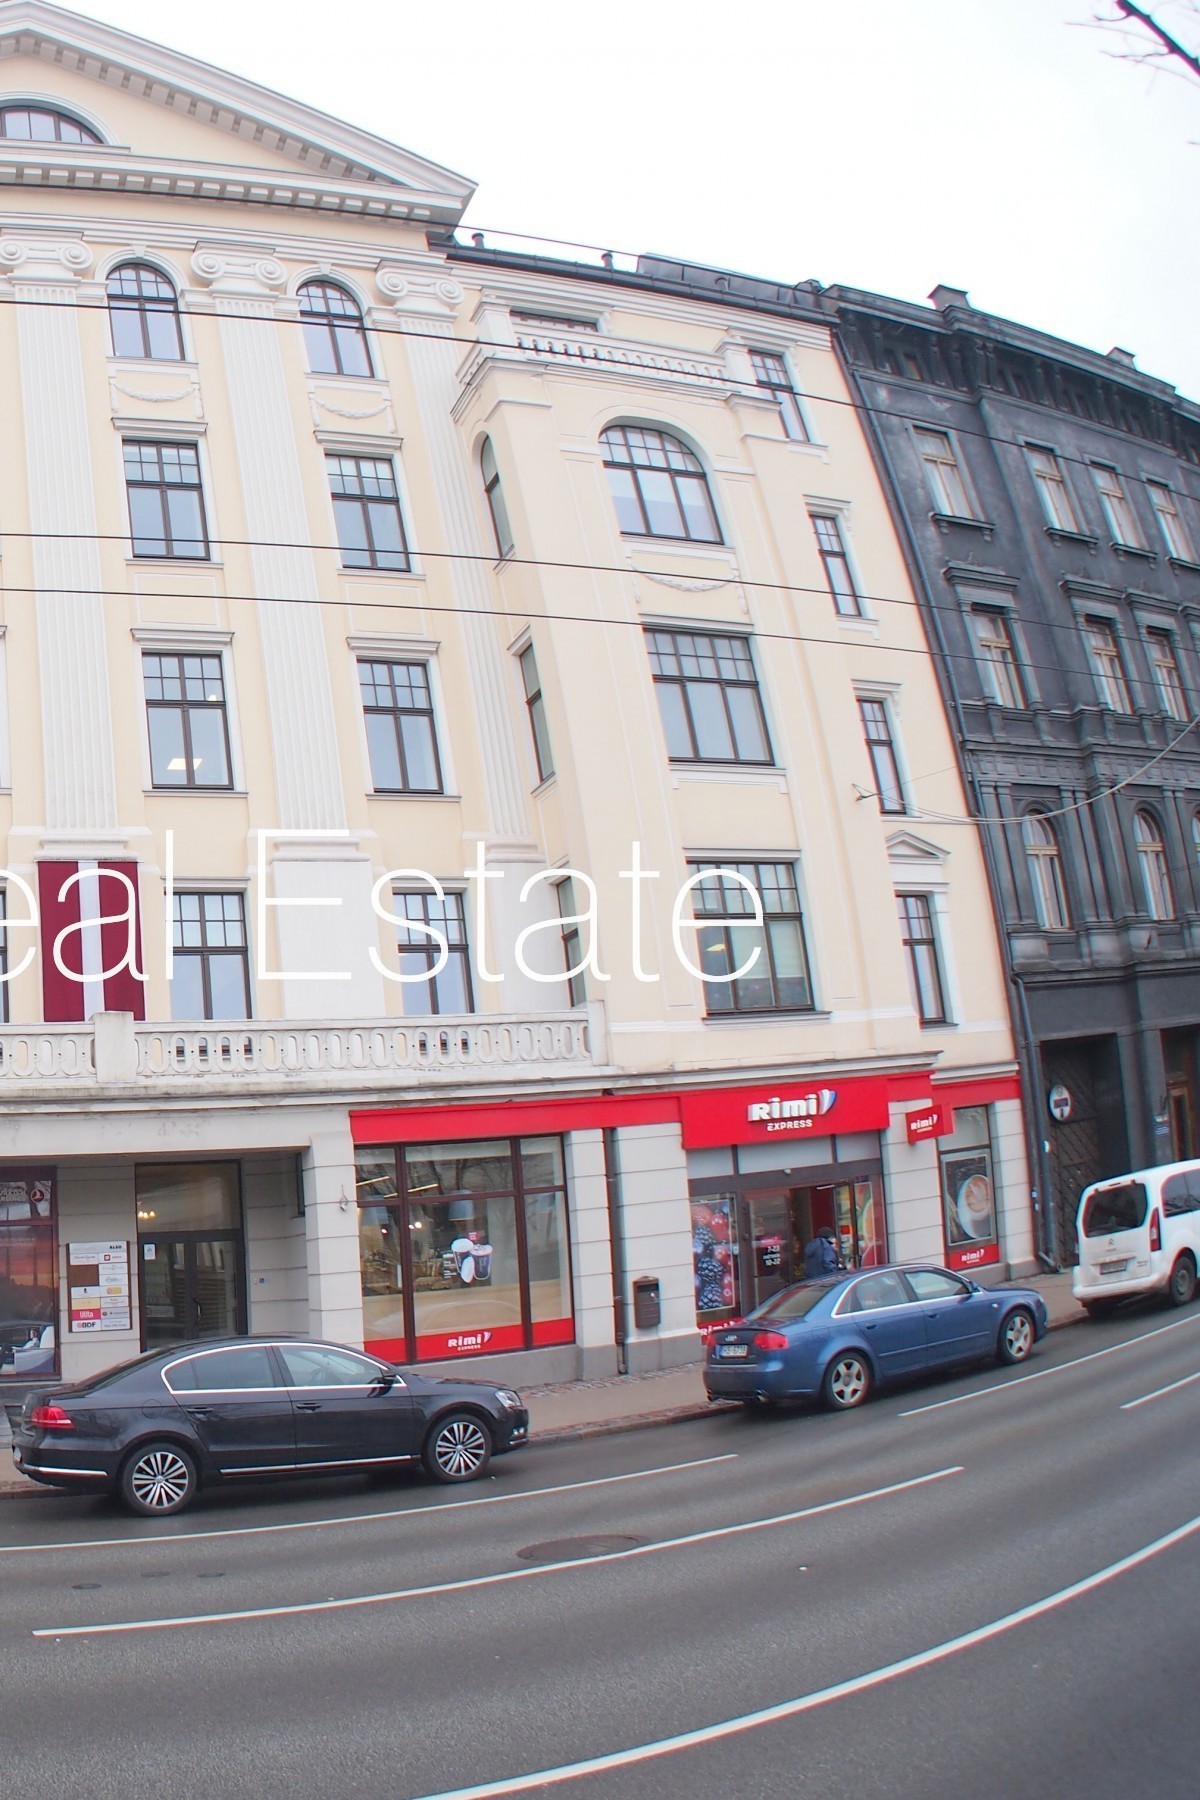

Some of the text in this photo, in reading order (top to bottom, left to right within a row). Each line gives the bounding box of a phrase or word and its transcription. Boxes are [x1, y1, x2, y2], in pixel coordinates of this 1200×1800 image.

[747, 1092, 818, 1122] Rimi
[766, 1118, 813, 1132] EXPRESS
[910, 1116, 933, 1131] Rimi
[961, 1250, 980, 1262] Rimi
[447, 1333, 482, 1347] Rimi
